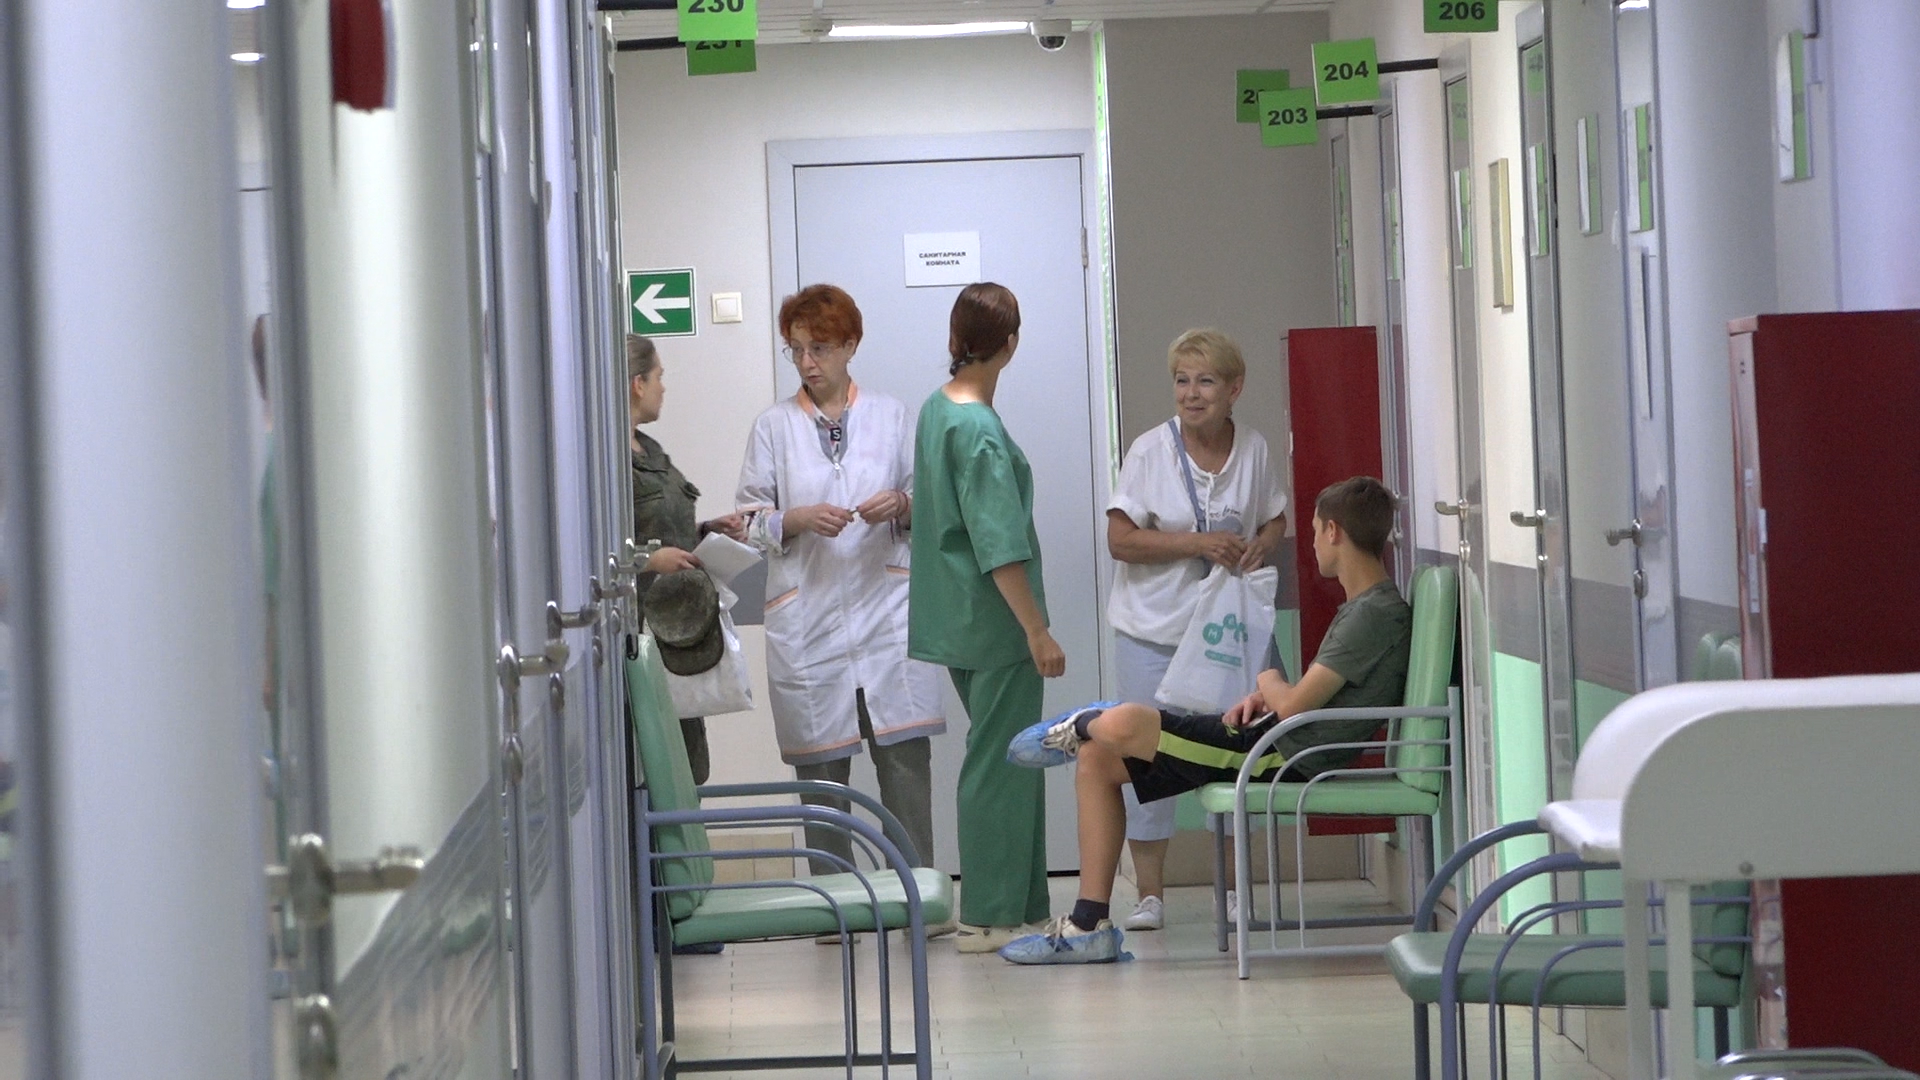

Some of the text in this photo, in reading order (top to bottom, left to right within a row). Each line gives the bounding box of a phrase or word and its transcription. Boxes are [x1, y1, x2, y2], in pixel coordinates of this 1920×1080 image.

[688, 0, 744, 13] 230
[1439, 2, 1486, 21] 206
[1323, 61, 1369, 82] 204
[1267, 107, 1308, 126] 203
[919, 251, 967, 259] САНИТАРНАЯ
